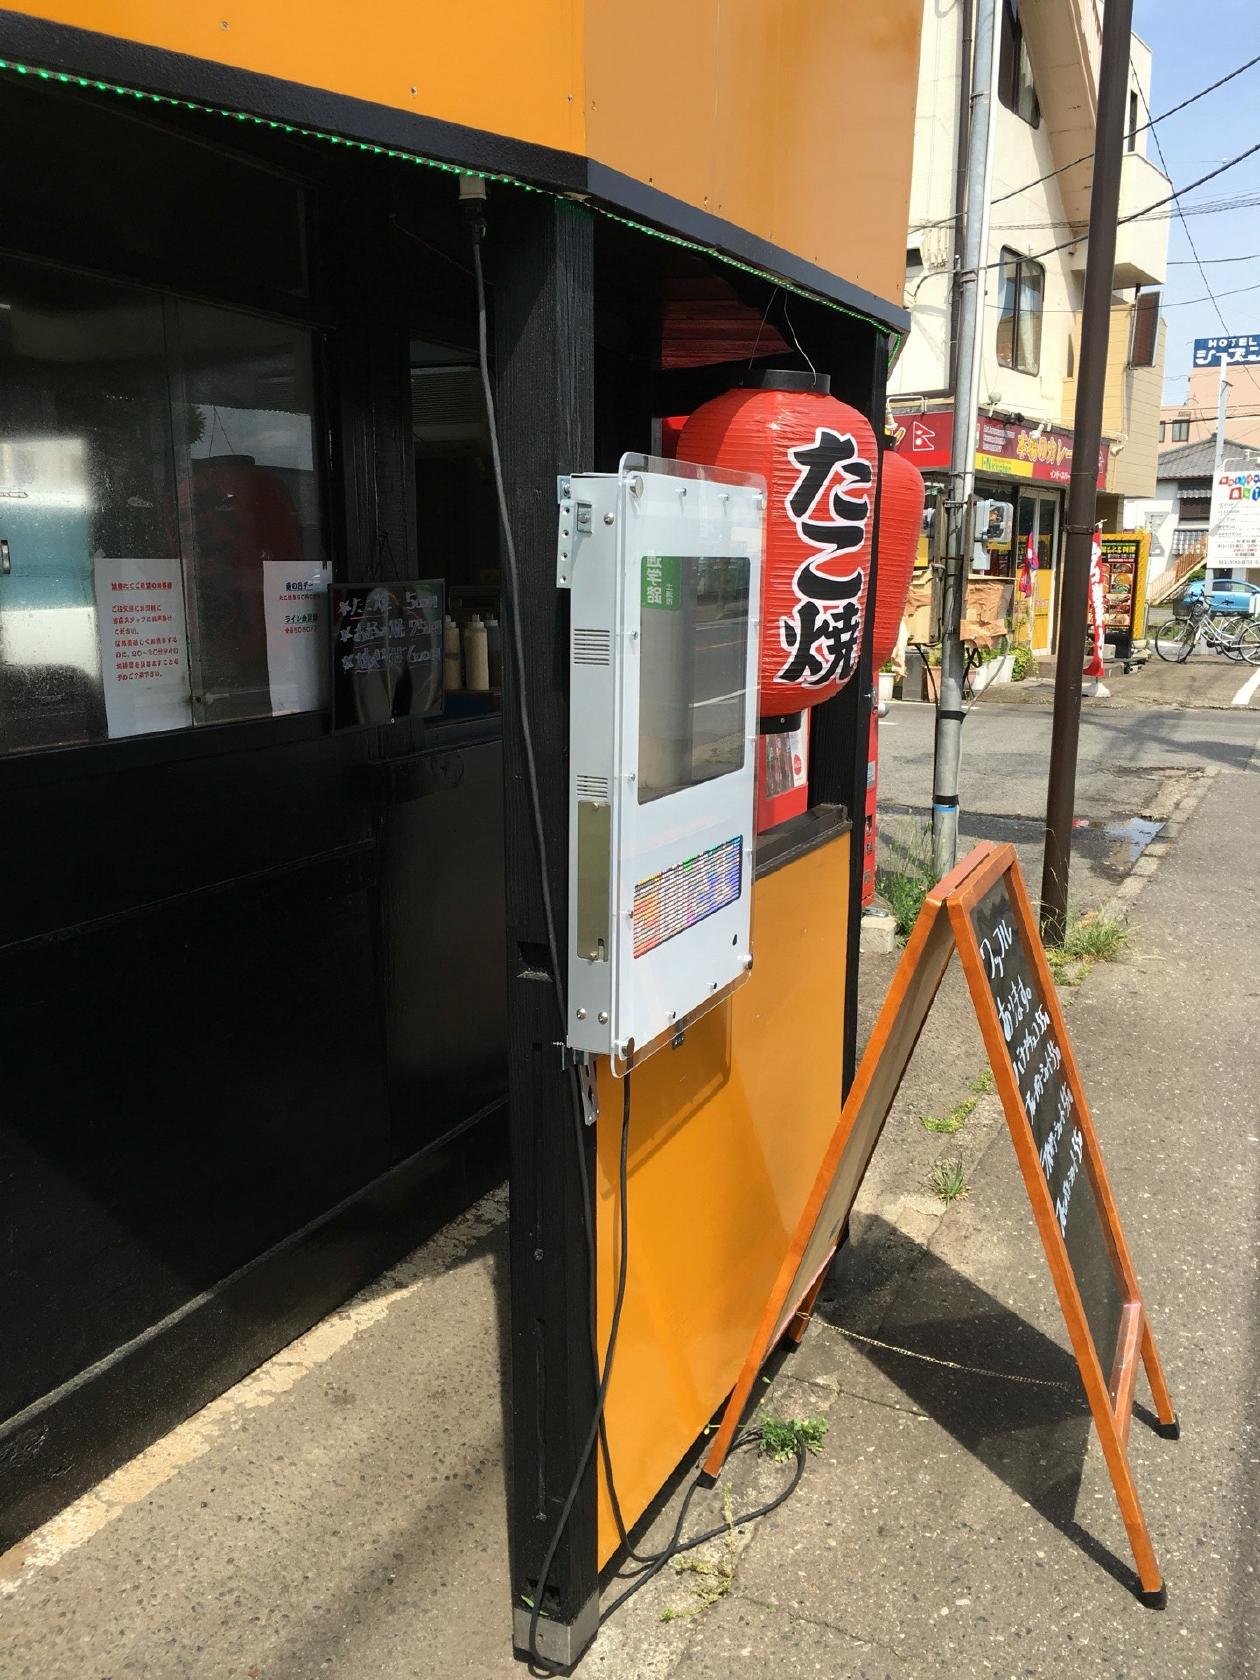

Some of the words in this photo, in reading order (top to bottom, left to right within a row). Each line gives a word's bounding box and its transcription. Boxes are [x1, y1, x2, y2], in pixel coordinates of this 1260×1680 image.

[1208, 337, 1257, 348] HOTEL
[776, 428, 873, 688] たこ焼
[980, 919, 1013, 979] ワッフル
